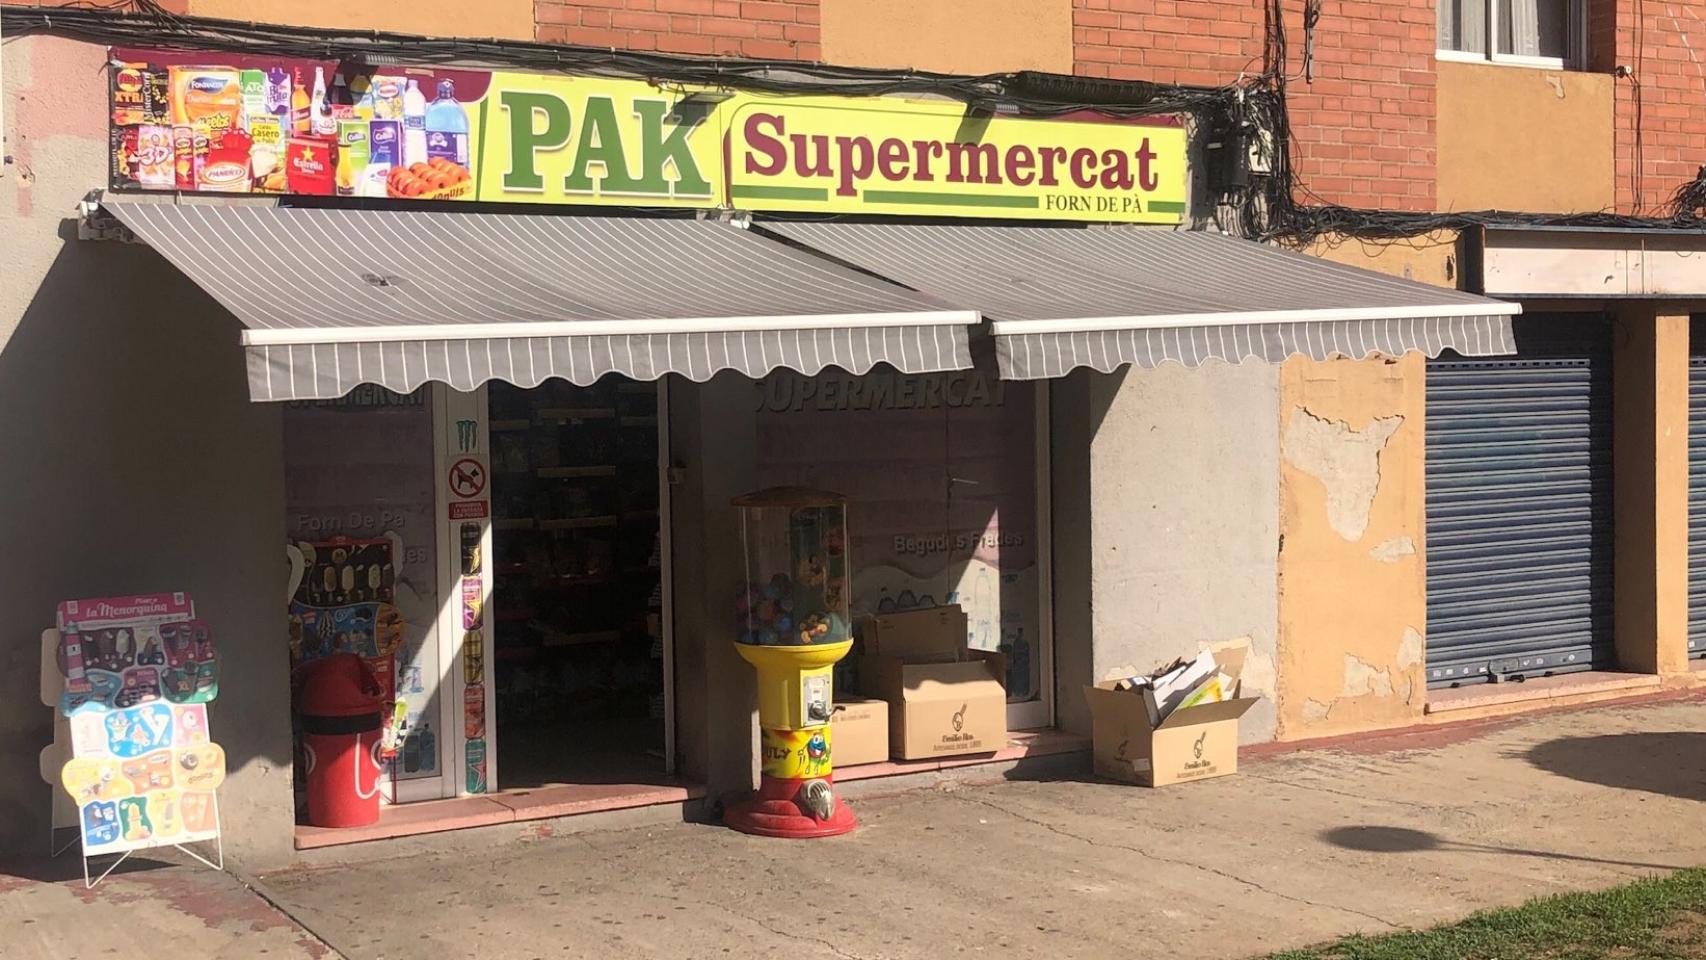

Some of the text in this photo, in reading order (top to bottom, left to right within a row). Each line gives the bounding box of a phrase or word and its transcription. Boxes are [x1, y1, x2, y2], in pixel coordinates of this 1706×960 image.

[251, 128, 280, 138] Casero
[501, 91, 712, 197] PAK
[744, 113, 1159, 197] Supermercat
[1046, 194, 1142, 214] FORN DE PÀ
[298, 513, 343, 531] Forn
[350, 512, 375, 529] De
[97, 601, 168, 618] Menorquina
